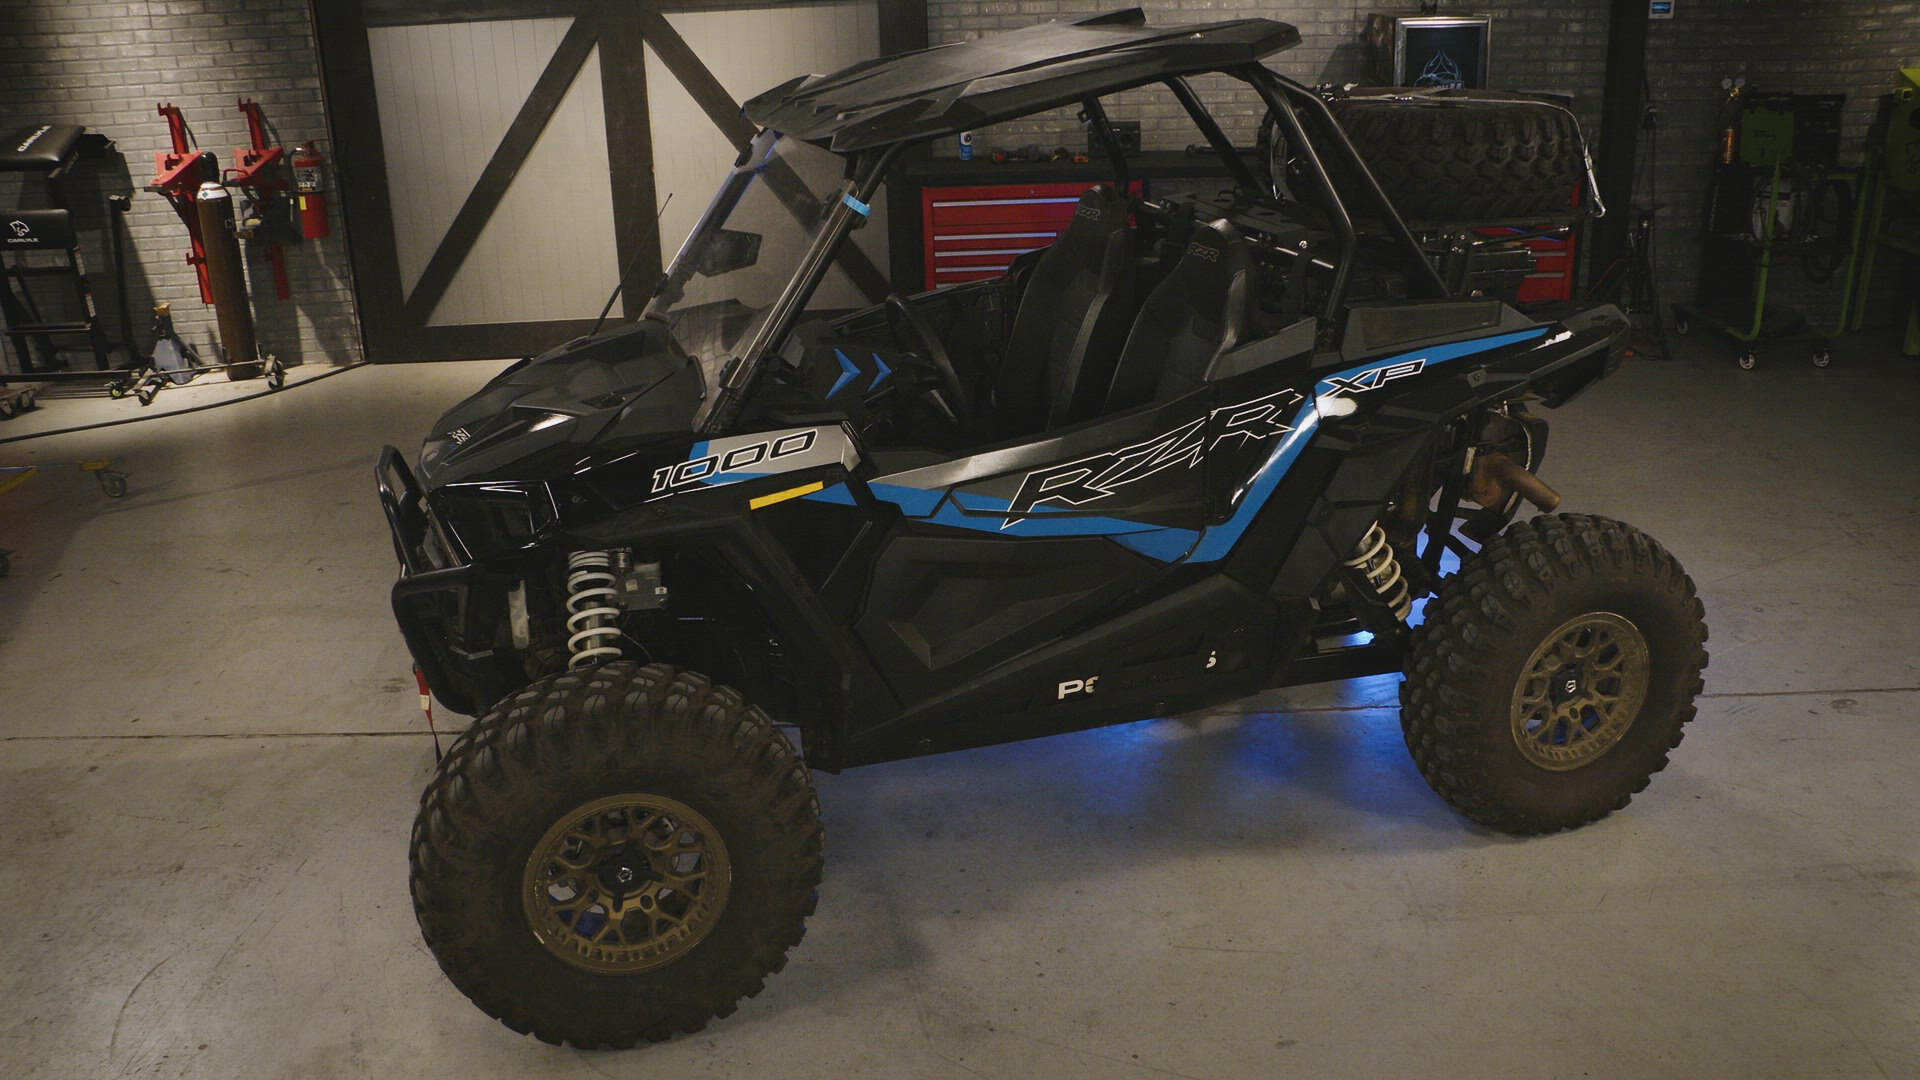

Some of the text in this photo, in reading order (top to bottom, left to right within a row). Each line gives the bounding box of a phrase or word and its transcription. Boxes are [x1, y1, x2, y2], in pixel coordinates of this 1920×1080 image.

[1187, 241, 1220, 262] RZR
[1315, 358, 1427, 400] XP
[650, 428, 818, 493] 1000
[1000, 387, 1304, 530] RZR
